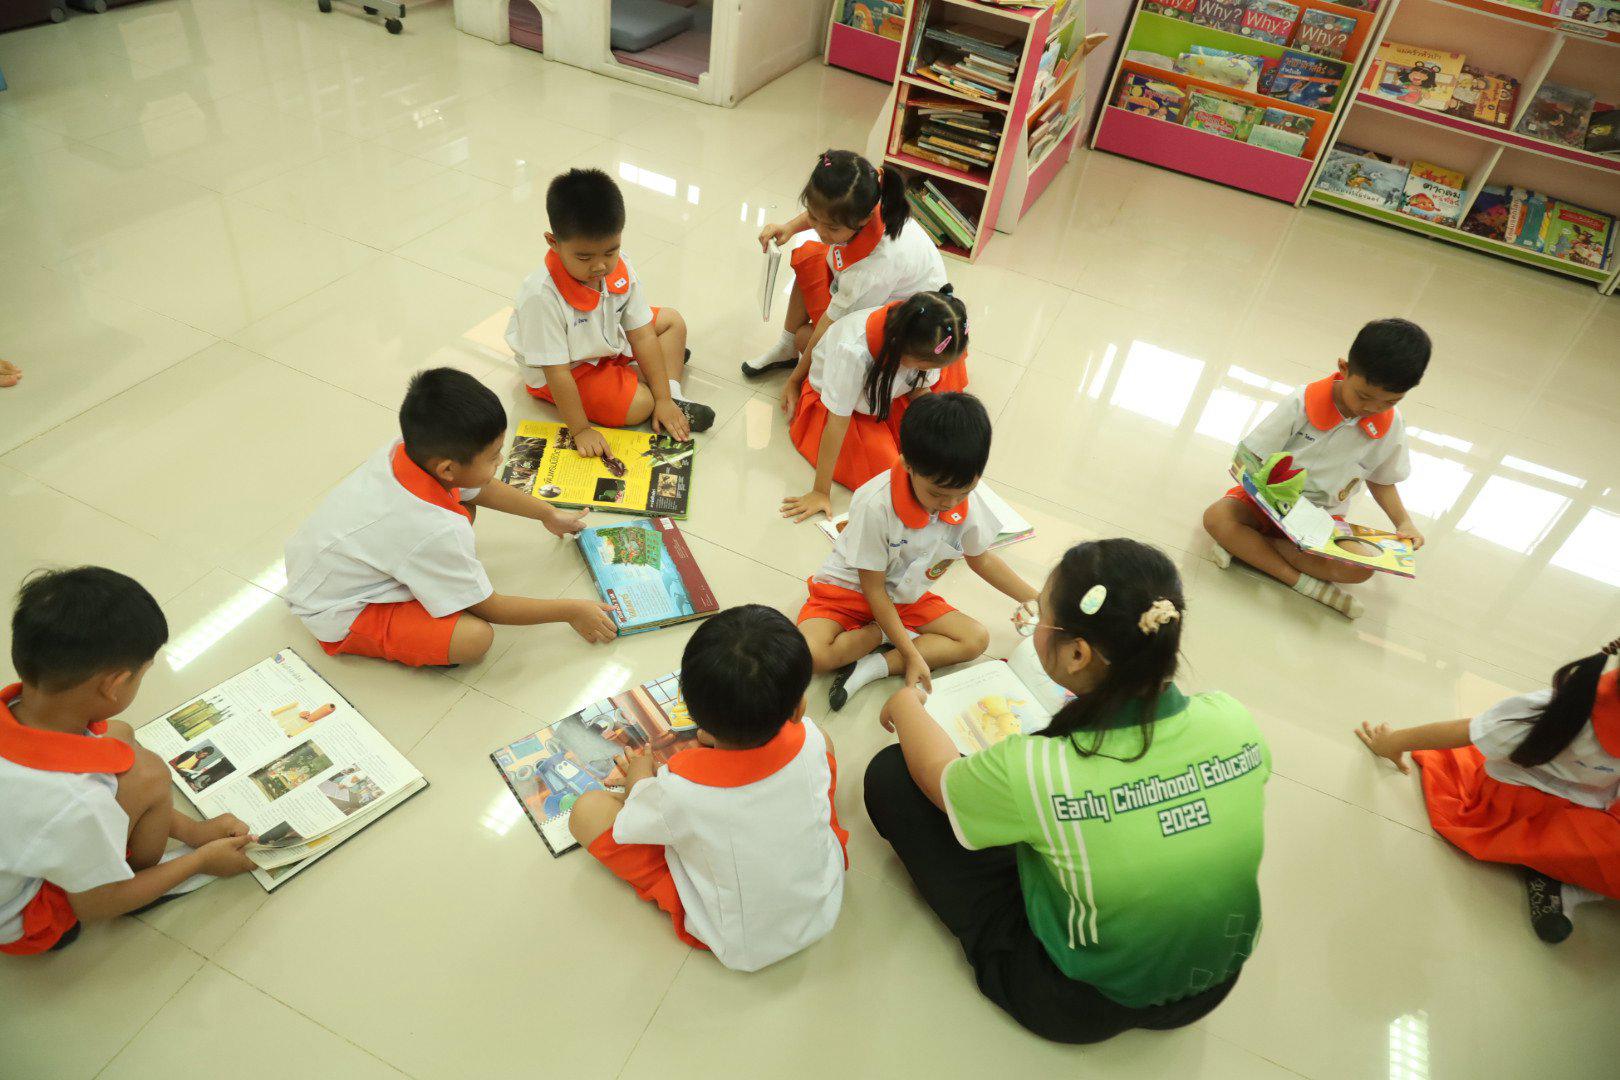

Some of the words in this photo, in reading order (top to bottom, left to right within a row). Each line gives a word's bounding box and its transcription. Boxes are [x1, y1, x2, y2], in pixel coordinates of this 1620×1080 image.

[1198, 1, 1243, 21] Why?
[1246, 11, 1291, 34] Why?
[1301, 25, 1347, 47] Why?
[1051, 791, 1110, 822] Early
[1110, 765, 1200, 814] Childhood
[1157, 798, 1212, 837] 2022
